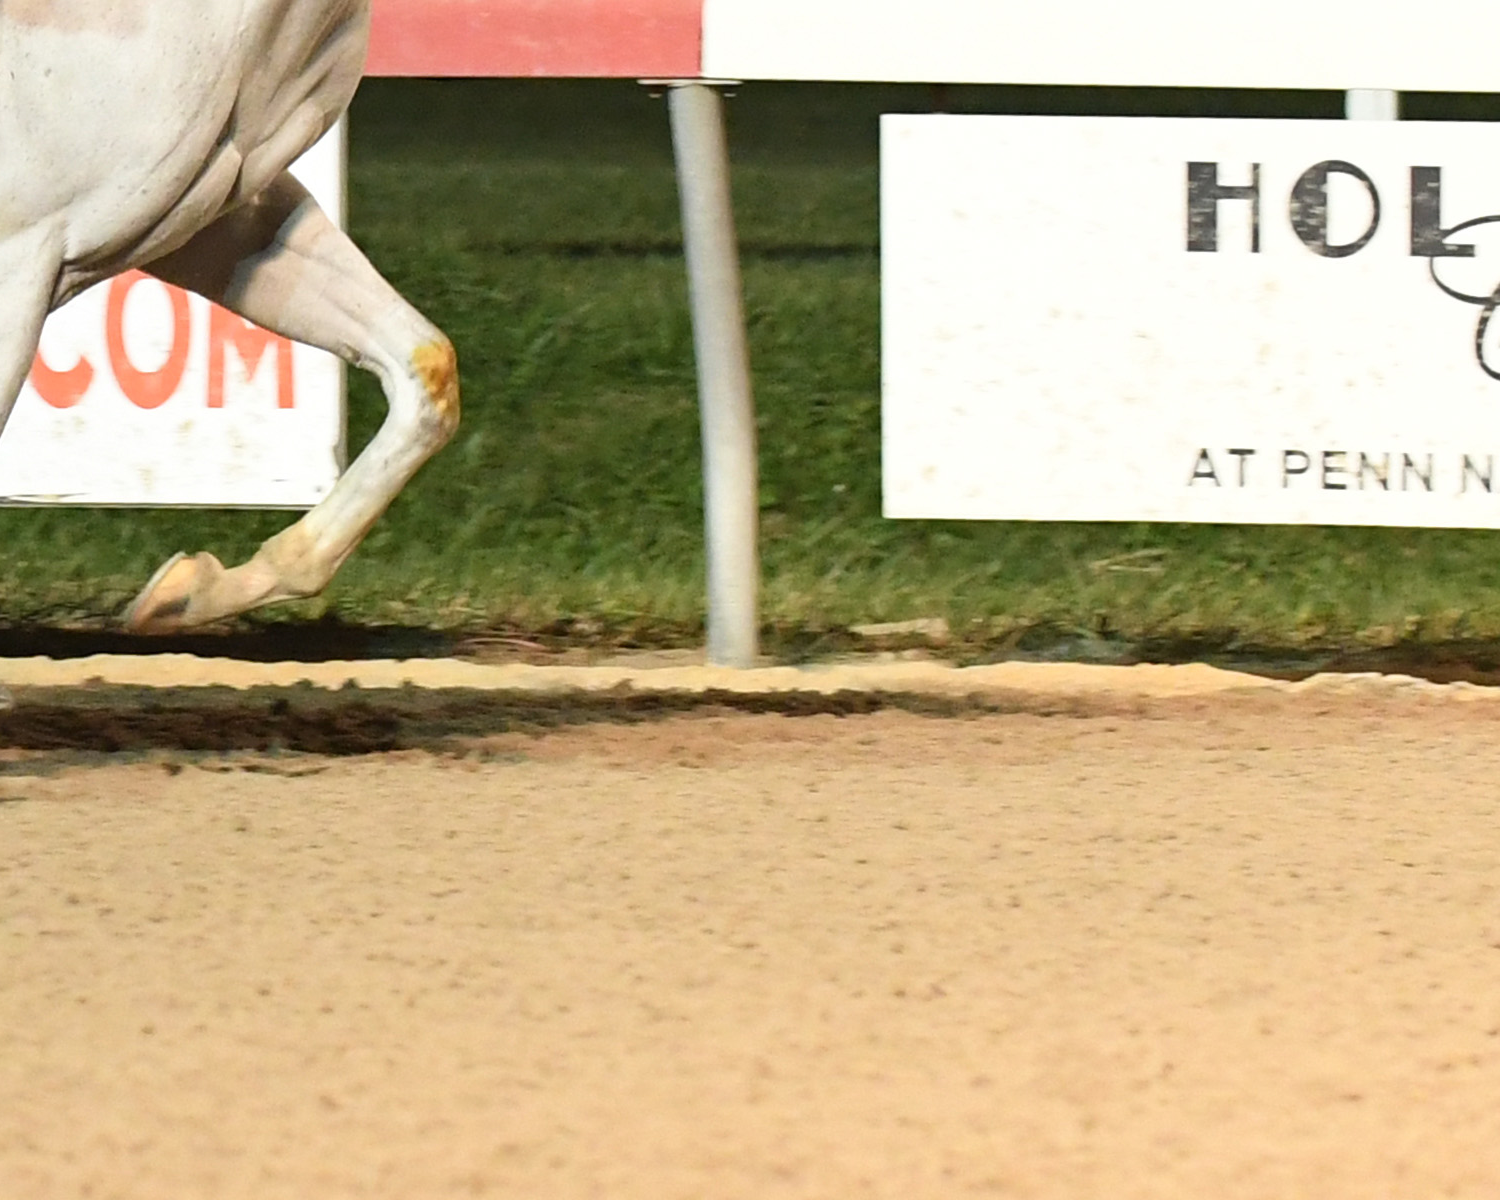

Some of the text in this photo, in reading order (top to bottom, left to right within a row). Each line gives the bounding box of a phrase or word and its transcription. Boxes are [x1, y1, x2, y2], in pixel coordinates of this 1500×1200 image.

[1187, 447, 1494, 493] AT PENN N
